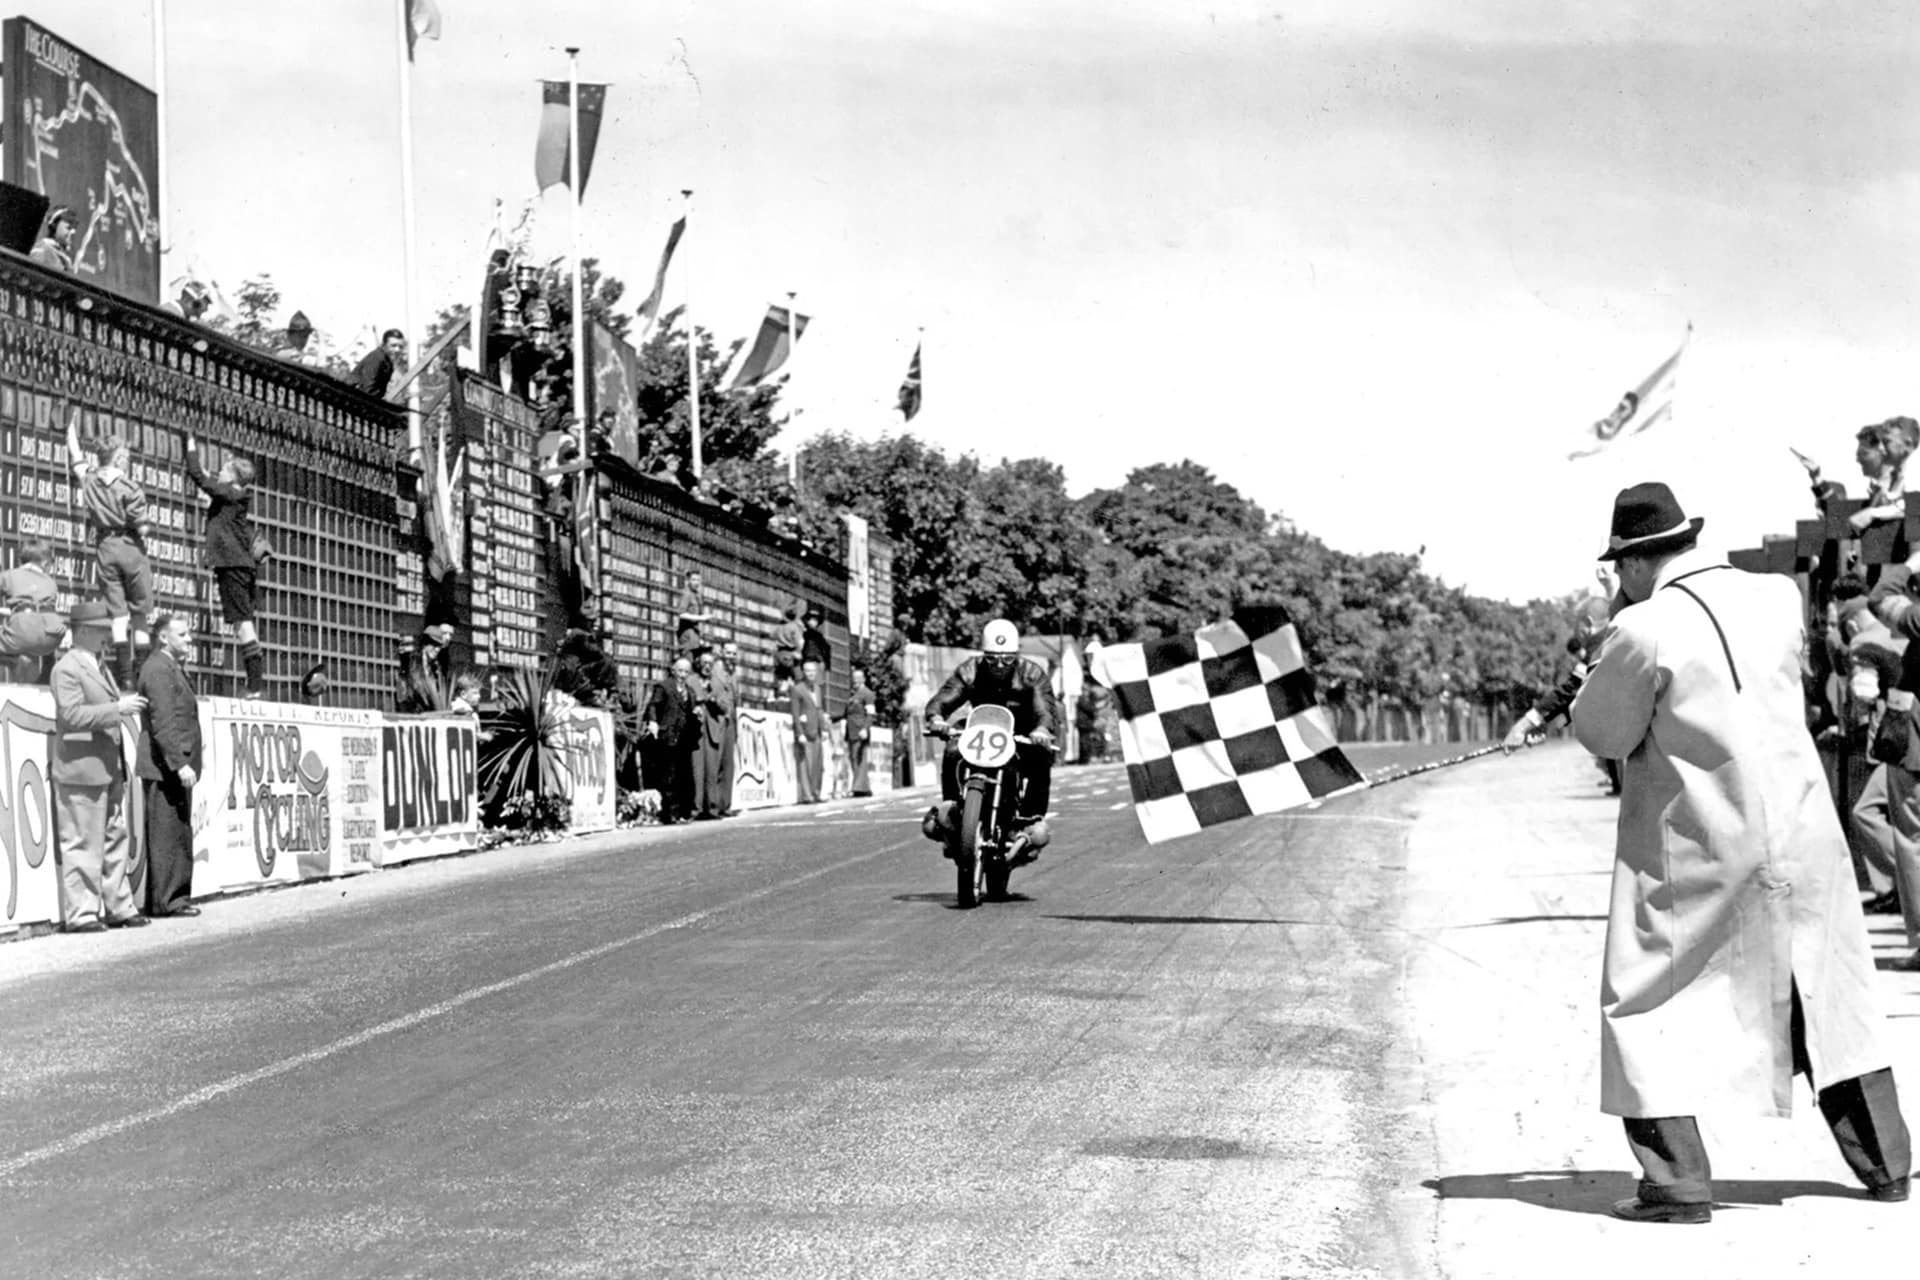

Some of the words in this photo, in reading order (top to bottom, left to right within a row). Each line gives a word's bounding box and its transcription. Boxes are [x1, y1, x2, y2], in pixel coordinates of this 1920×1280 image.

[41, 33, 80, 78] COURSE
[228, 722, 302, 810] MOTOR
[382, 725, 475, 832] DUNLOP
[967, 730, 1008, 760] 49
[253, 783, 330, 878] CYCLING
